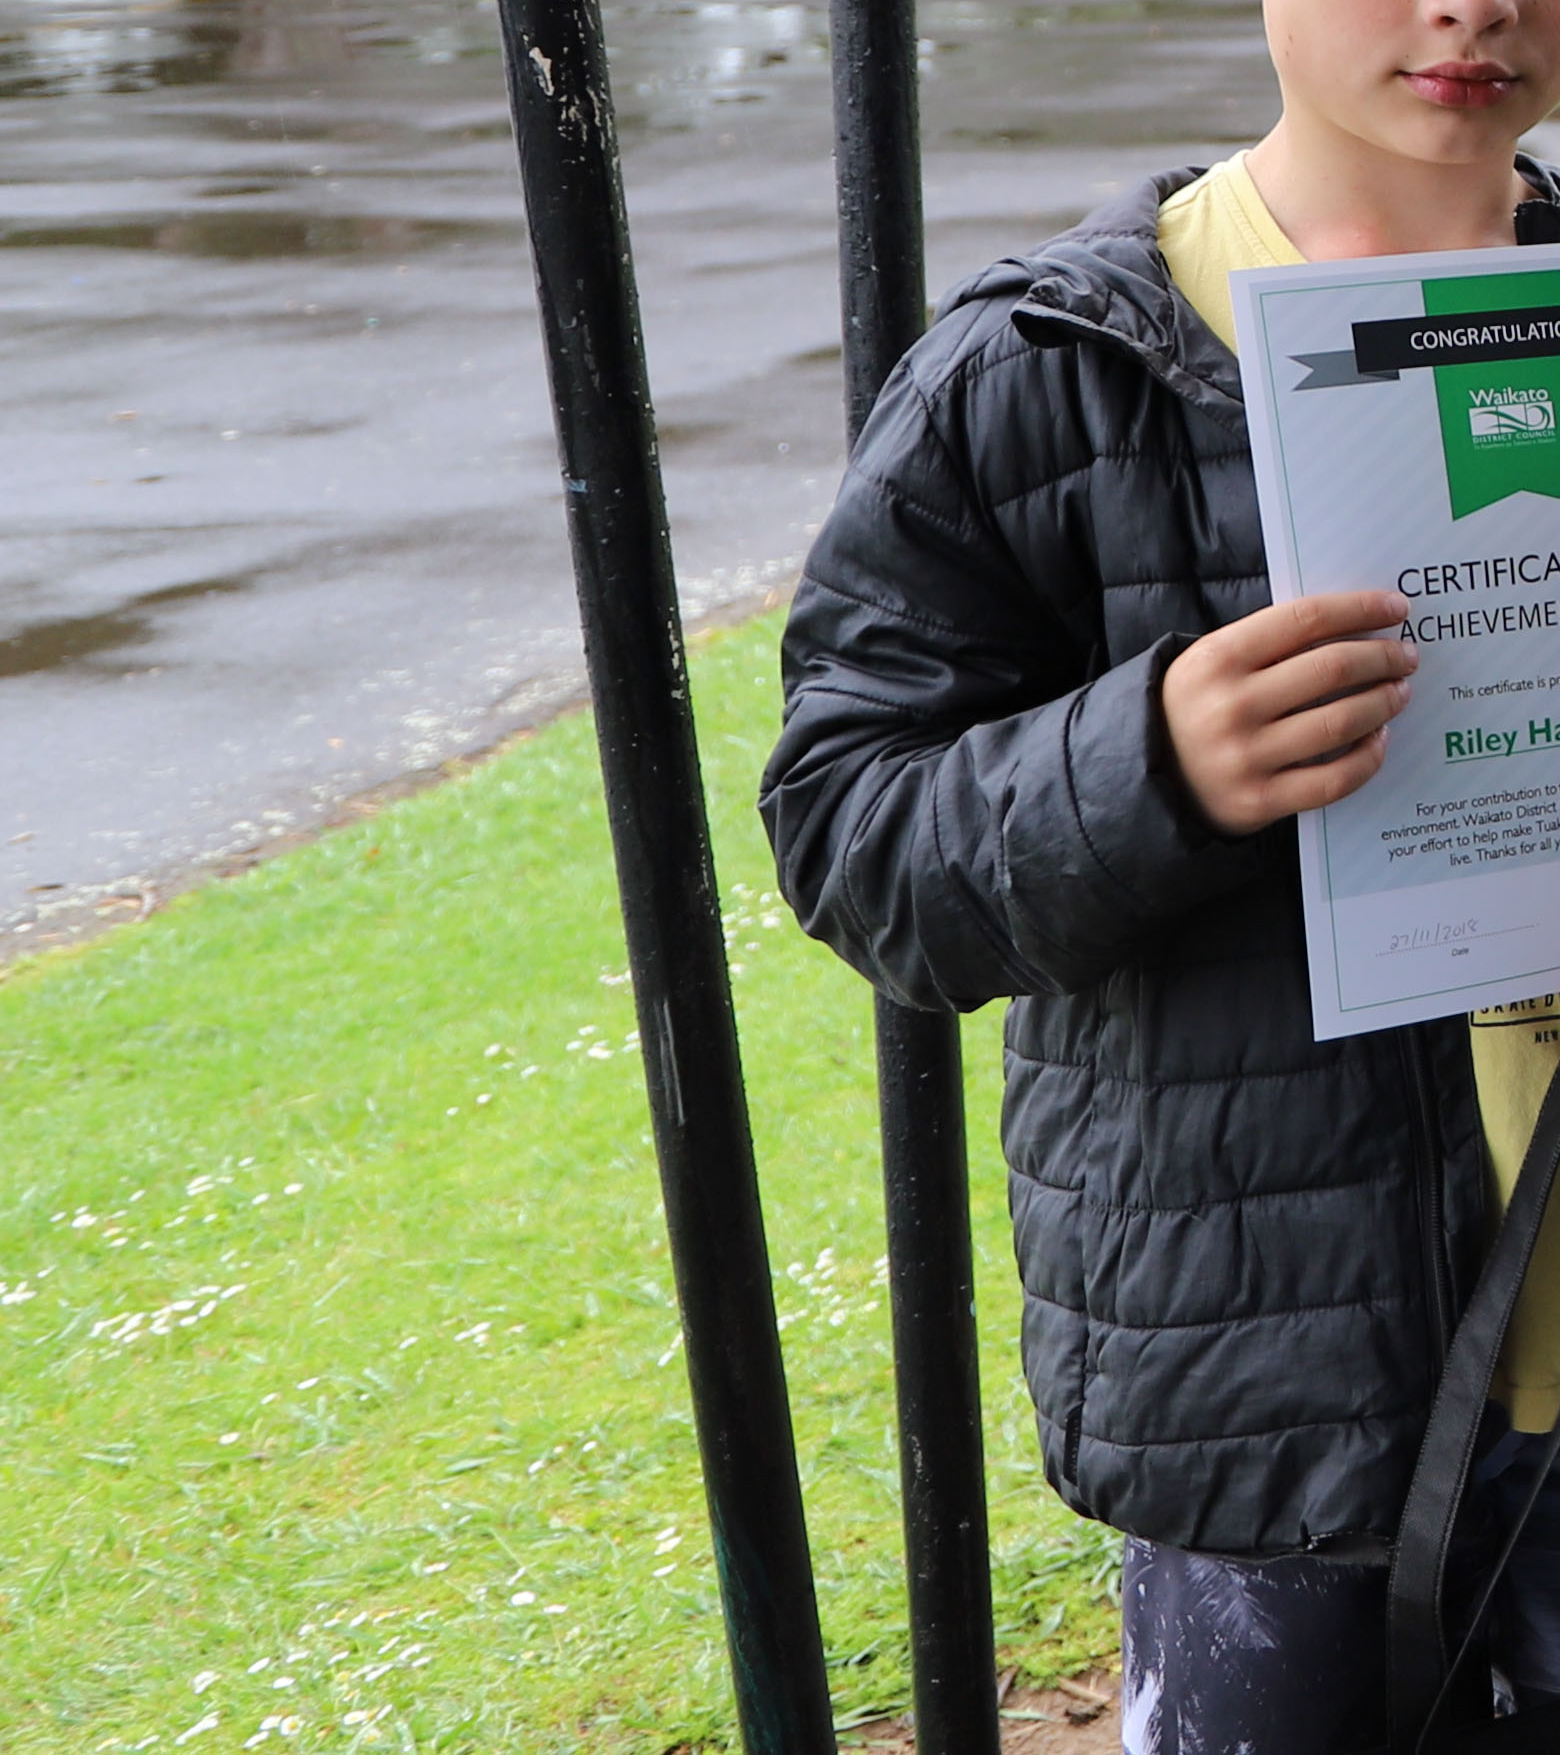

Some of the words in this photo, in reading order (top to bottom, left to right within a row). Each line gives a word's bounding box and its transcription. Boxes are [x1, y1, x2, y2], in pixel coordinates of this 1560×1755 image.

[1469, 387, 1548, 406] Waikato
[1472, 433, 1512, 444] DISTRICT
[1516, 431, 1556, 439] COUNCIL
[1448, 685, 1474, 700] This
[1477, 679, 1534, 696] certificate
[1537, 676, 1546, 688] is
[1444, 727, 1519, 760] Riley
[1415, 802, 1437, 816] For
[1439, 799, 1468, 816] your
[1470, 787, 1542, 808] contribution
[1544, 784, 1557, 796] to
[1461, 810, 1512, 827] Waikato
[1516, 801, 1557, 819] District
[1387, 844, 1417, 861] your
[1419, 837, 1453, 853] effort
[1455, 836, 1470, 847] to
[1472, 829, 1498, 844] help
[1501, 823, 1532, 839] make
[1475, 844, 1517, 861] Thanks
[1519, 841, 1537, 854] for
[1539, 837, 1551, 851] all
